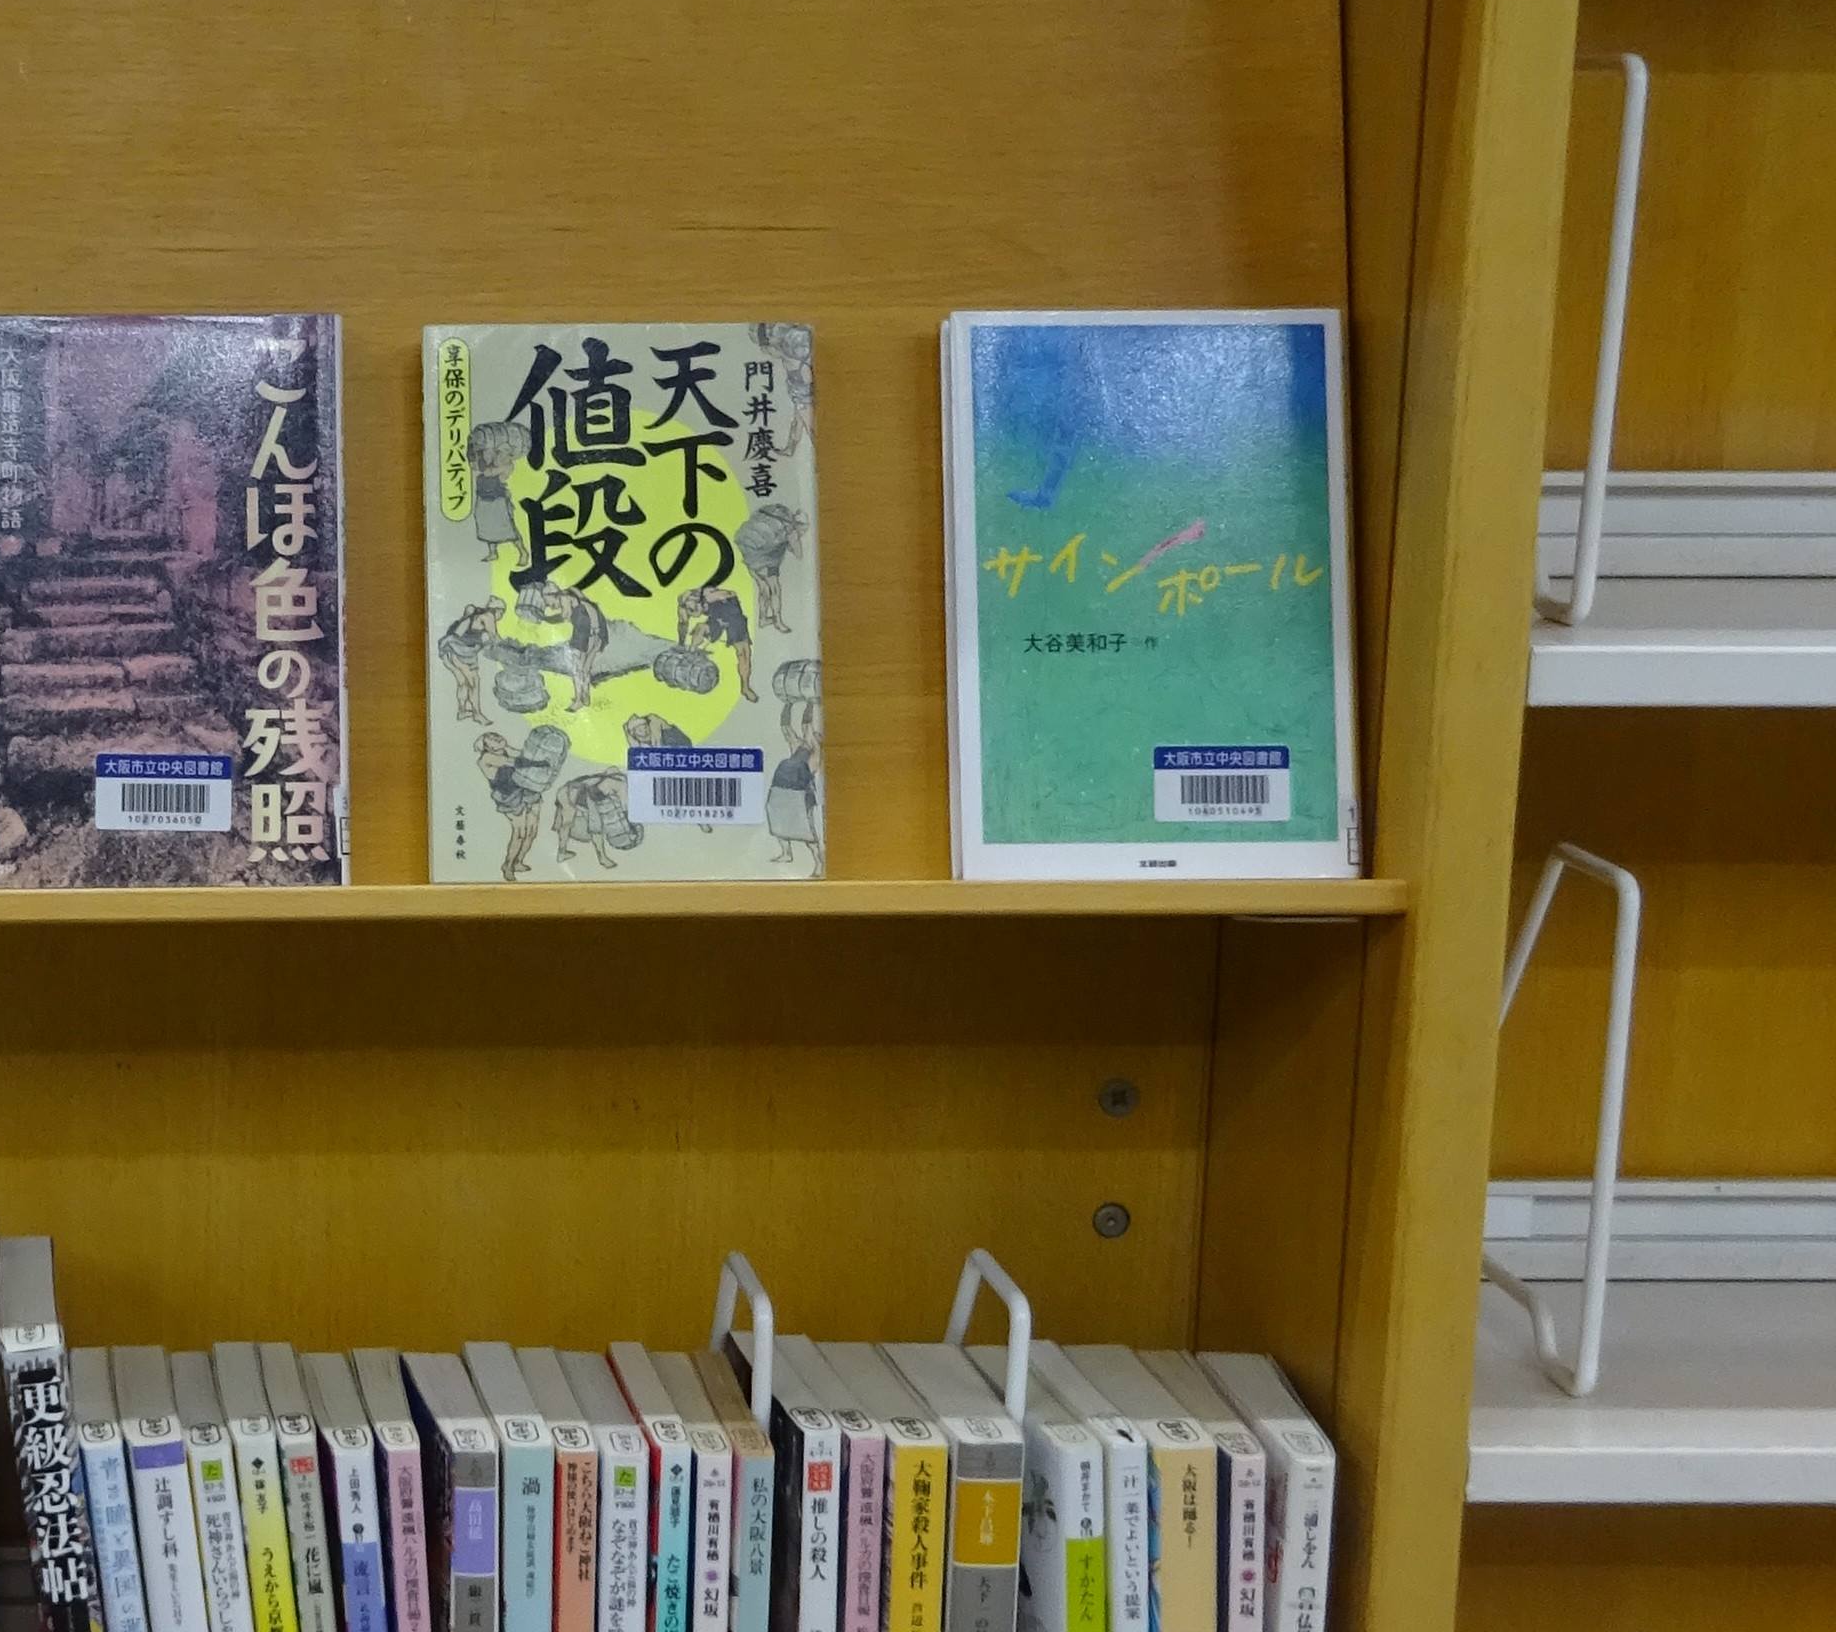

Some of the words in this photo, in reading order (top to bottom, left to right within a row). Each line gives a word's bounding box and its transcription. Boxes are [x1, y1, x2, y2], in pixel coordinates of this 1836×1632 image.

[442, 344, 466, 510] 享保のデリバティブ
[505, 337, 653, 599] 値段
[640, 341, 740, 591] 天下の
[744, 361, 777, 498] 門井慶喜
[104, 759, 224, 777] 大阪市立中央図書館
[635, 752, 755, 769] 大阪市立中央図書館
[1164, 750, 1282, 767] 大阪市立中央図書館
[16, 1368, 88, 1606] 更級忍法帖
[748, 1477, 769, 1577] 私の大阪八景
[809, 1495, 830, 1582] 推しの殺人
